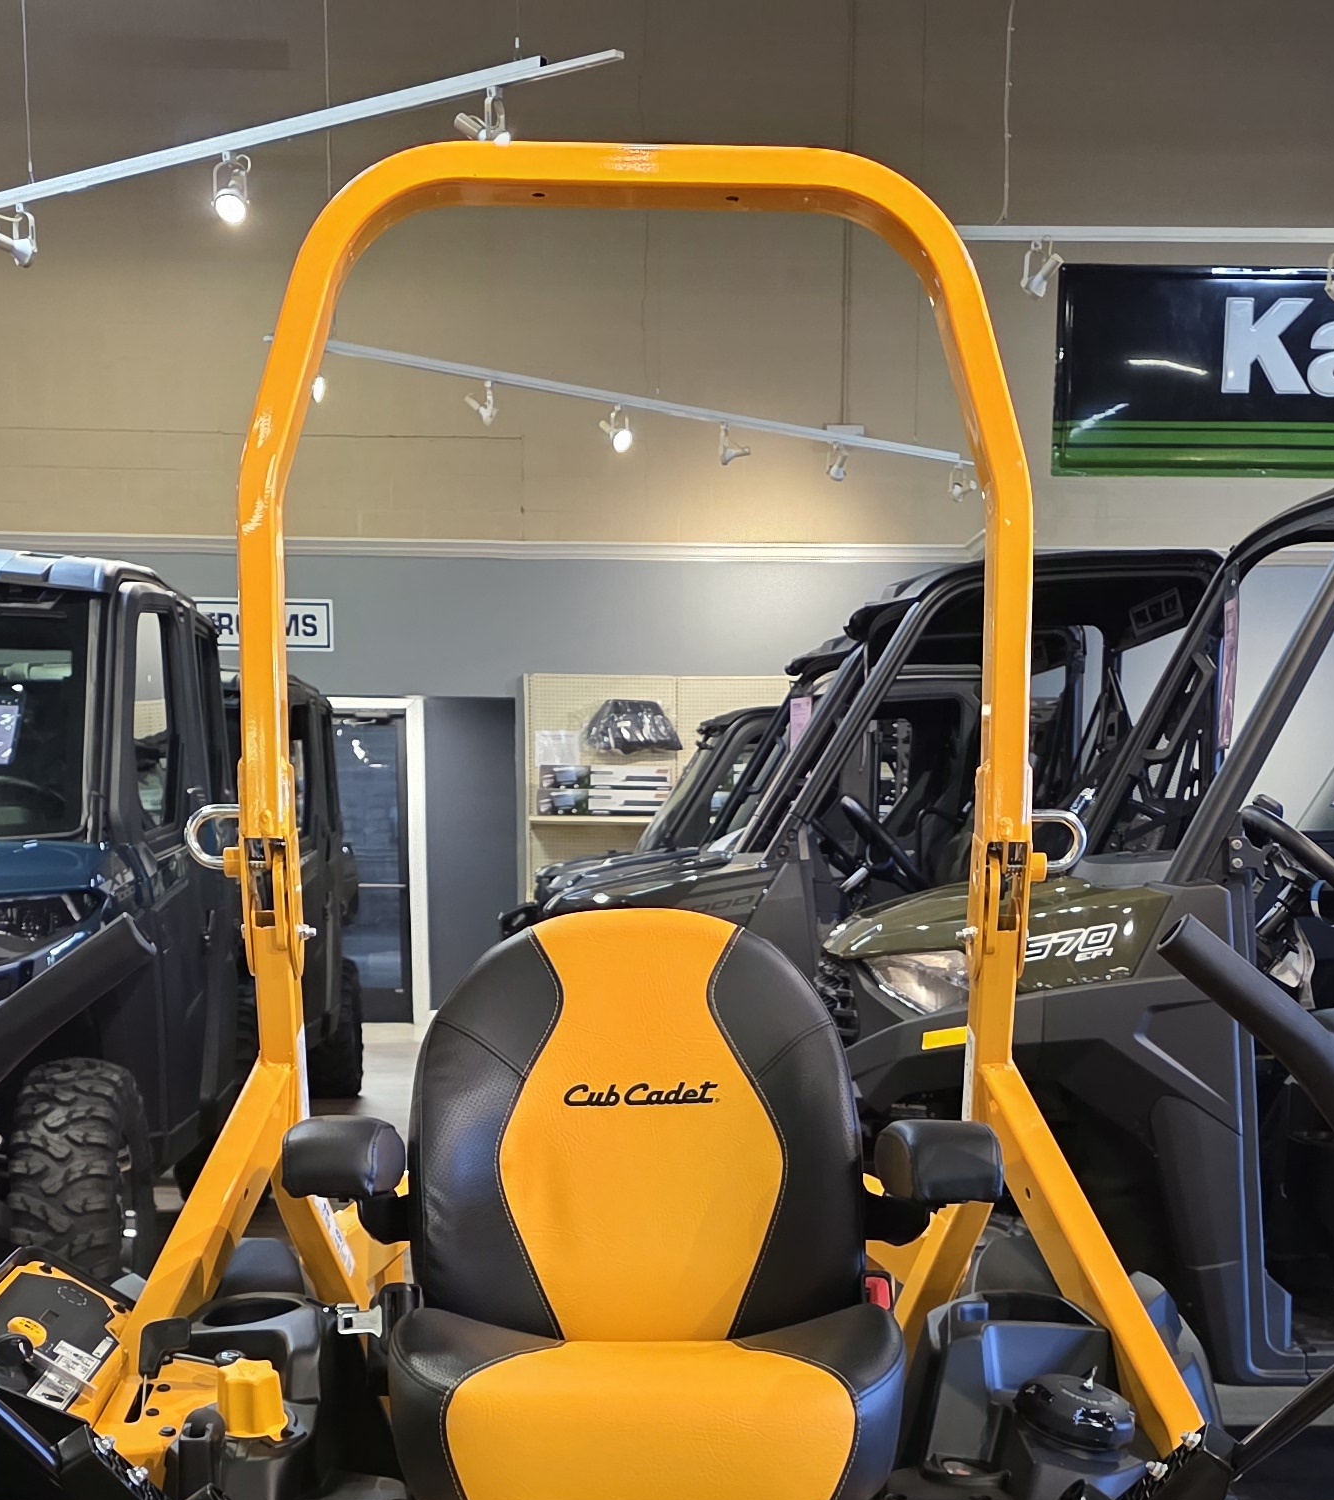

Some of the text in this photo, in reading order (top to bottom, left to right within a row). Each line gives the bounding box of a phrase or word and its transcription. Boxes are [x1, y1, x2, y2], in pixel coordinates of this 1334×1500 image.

[1024, 923, 1117, 962] 570
[1074, 947, 1114, 962] EFI
[563, 1081, 718, 1107] Cub Cadet
